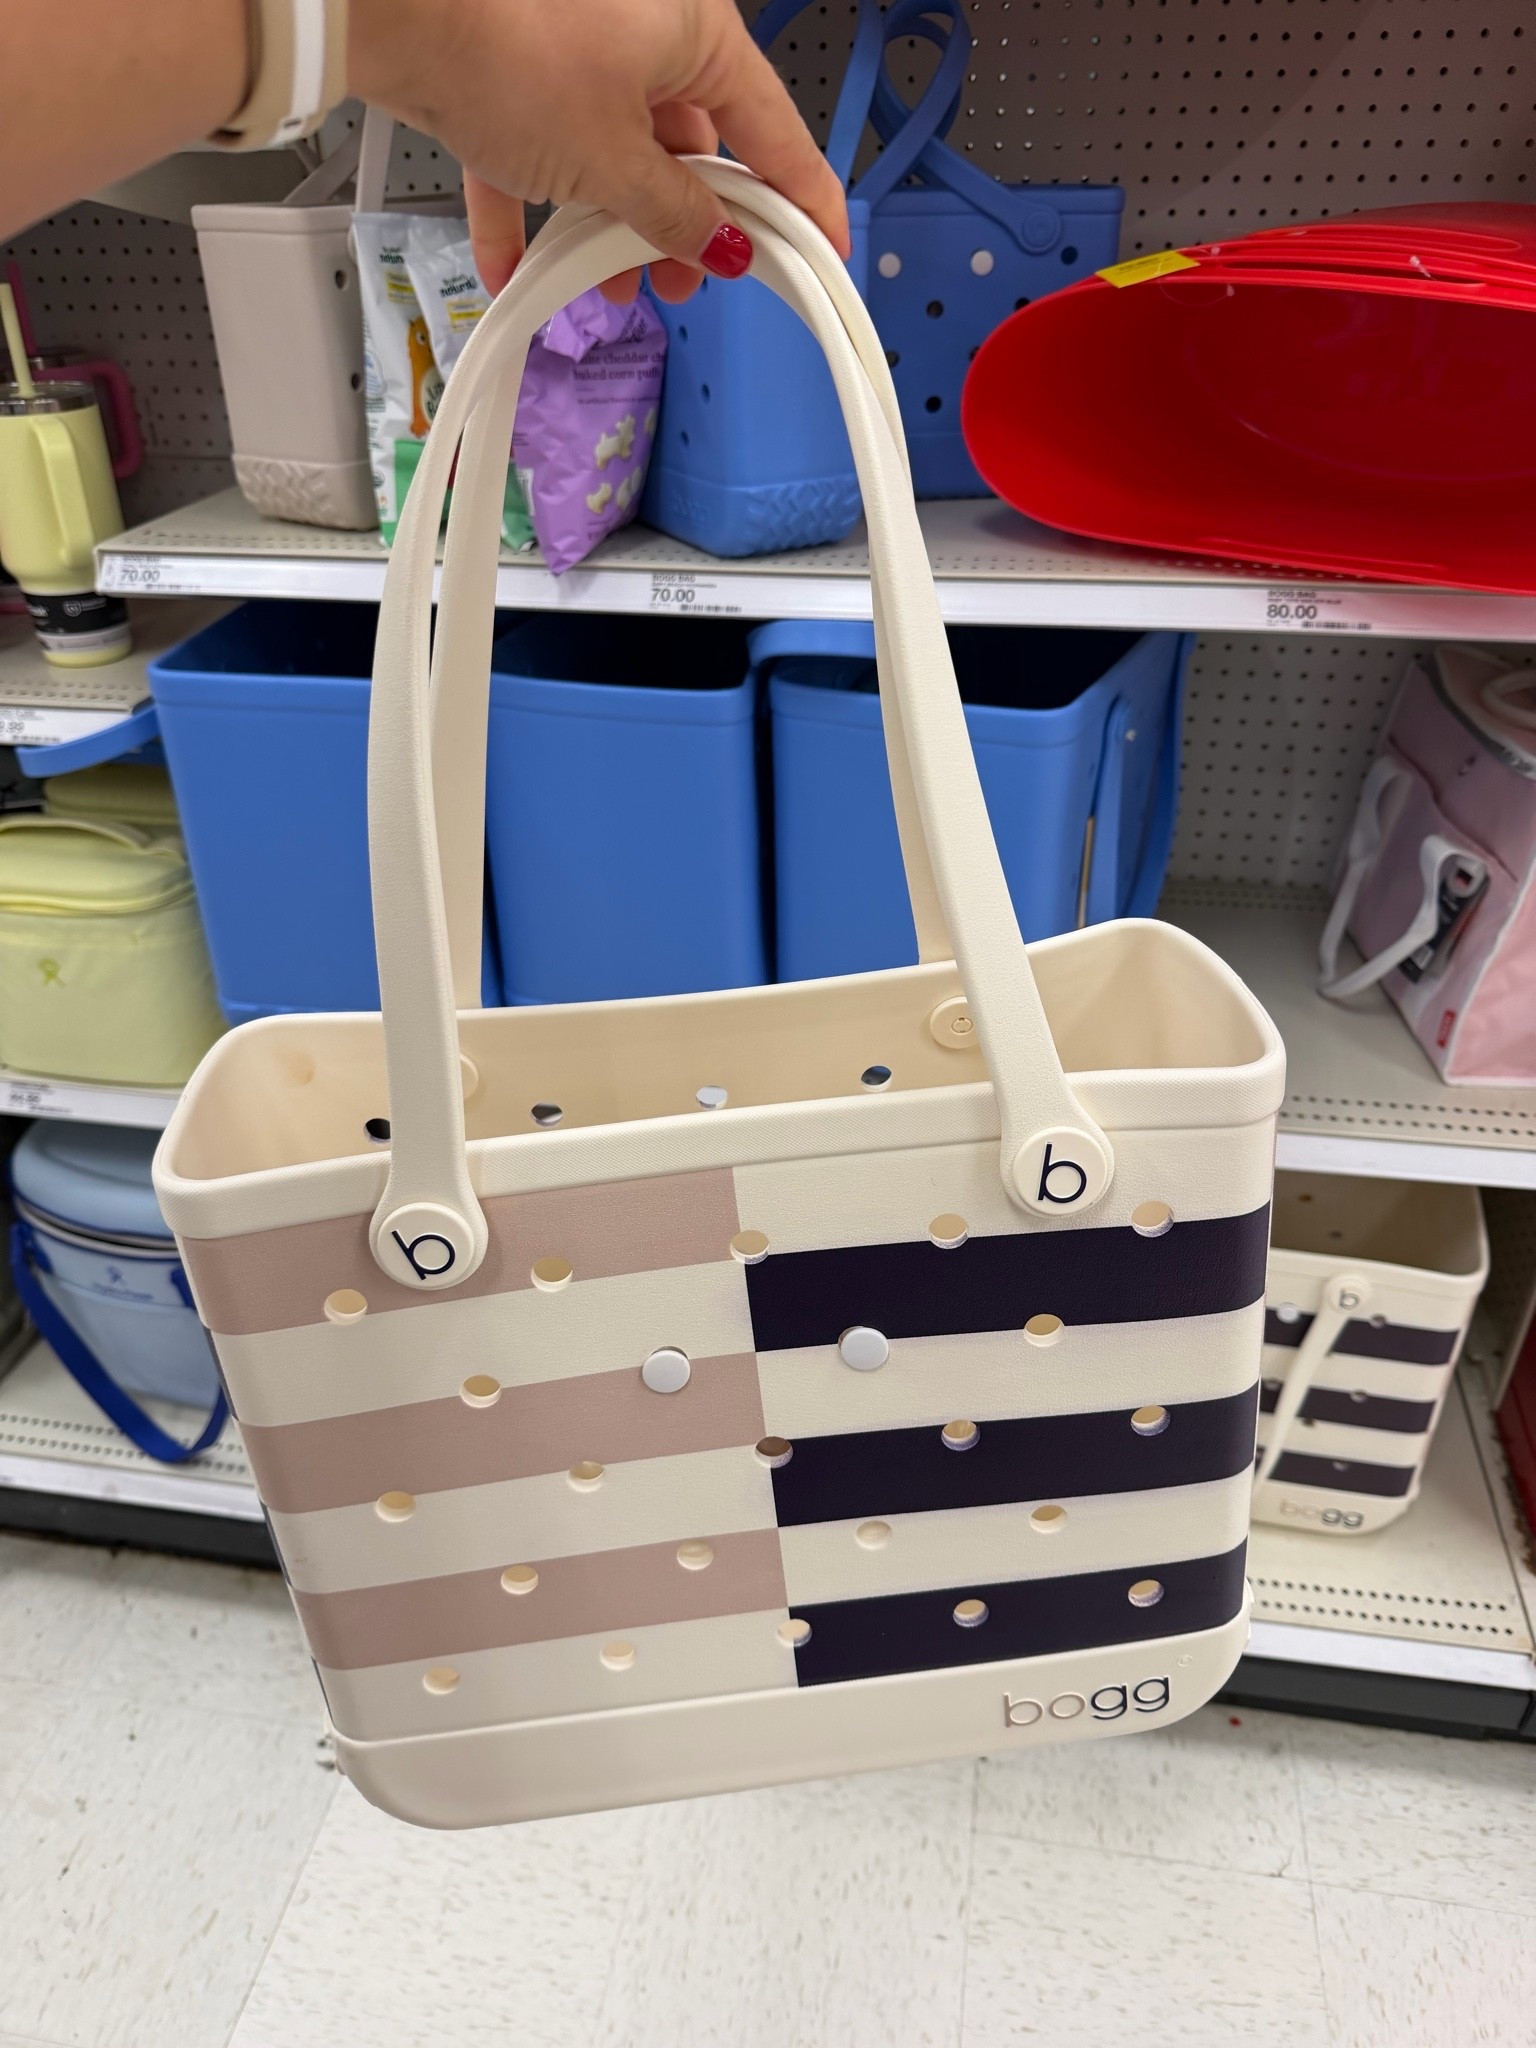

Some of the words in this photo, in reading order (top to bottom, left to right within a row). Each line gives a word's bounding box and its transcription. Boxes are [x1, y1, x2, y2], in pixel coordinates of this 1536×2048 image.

[121, 569, 160, 582] 70.00
[651, 588, 695, 602] 70.00
[1267, 604, 1317, 619] 80.00
[1038, 1143, 1087, 1203] b
[391, 1229, 455, 1280] b
[1340, 1288, 1360, 1310] b
[1280, 1499, 1364, 1529] bogg
[1004, 1675, 1169, 1728] bogg
